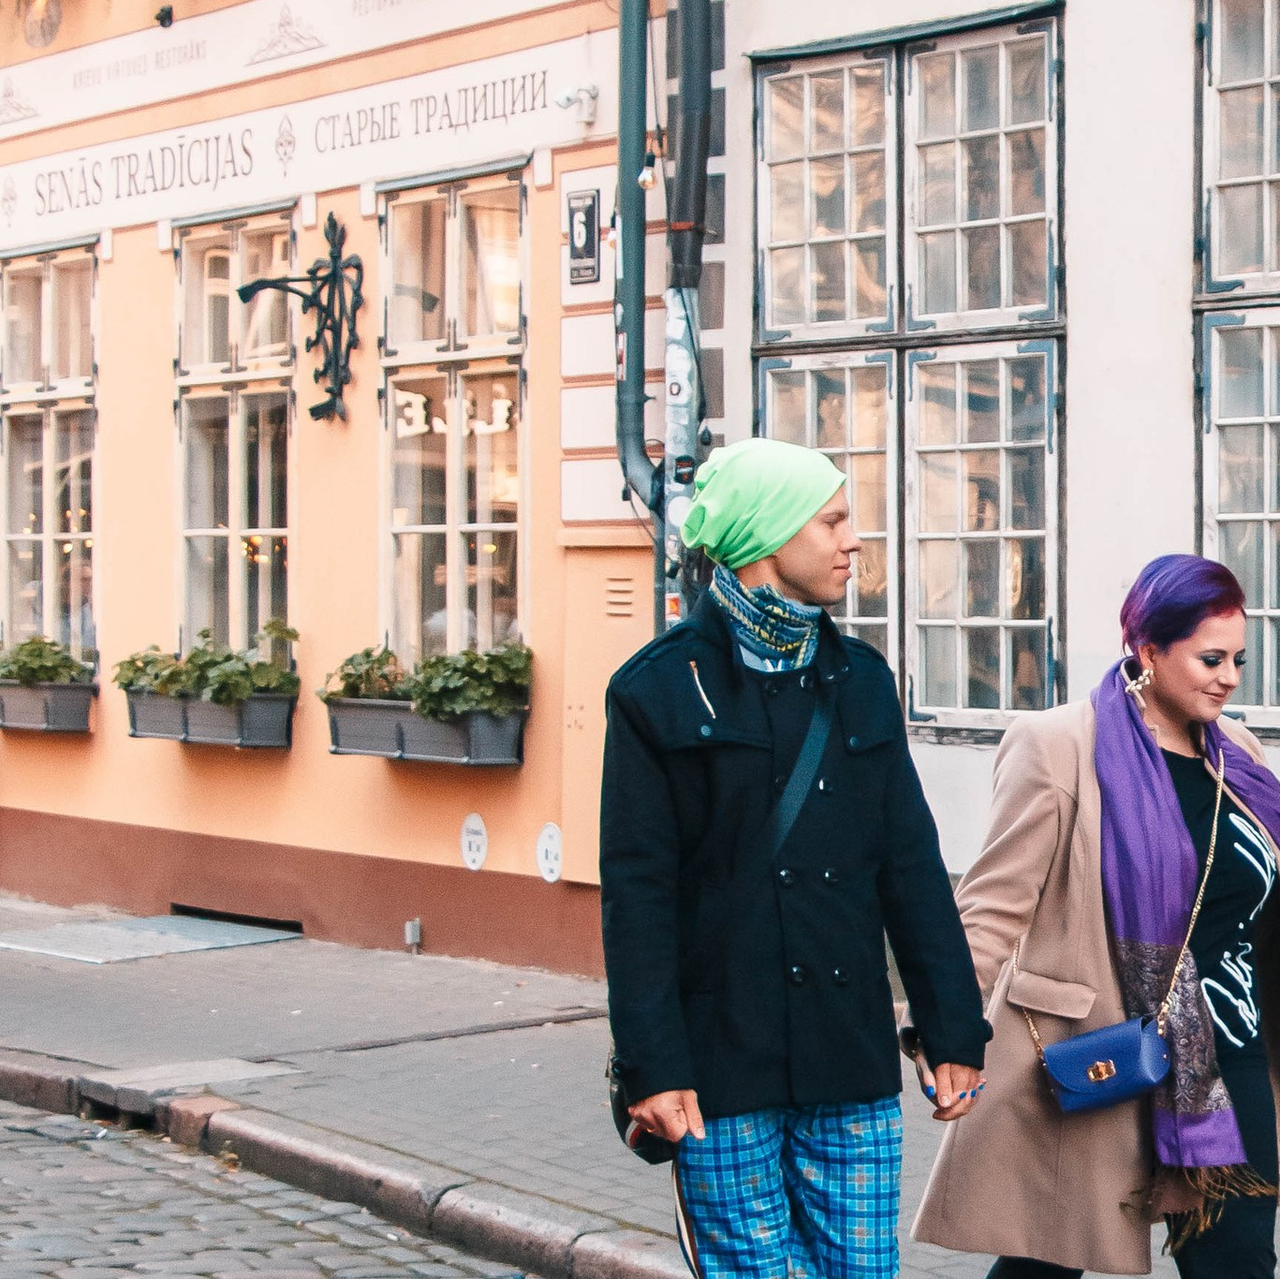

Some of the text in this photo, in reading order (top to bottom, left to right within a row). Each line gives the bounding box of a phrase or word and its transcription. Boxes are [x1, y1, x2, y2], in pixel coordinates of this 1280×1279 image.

[314, 69, 549, 153] СТАРЫЕ ТРАДИЦИИ
[35, 128, 255, 216] SENĀS TRADĪCIJAS
[572, 210, 587, 248] 6
